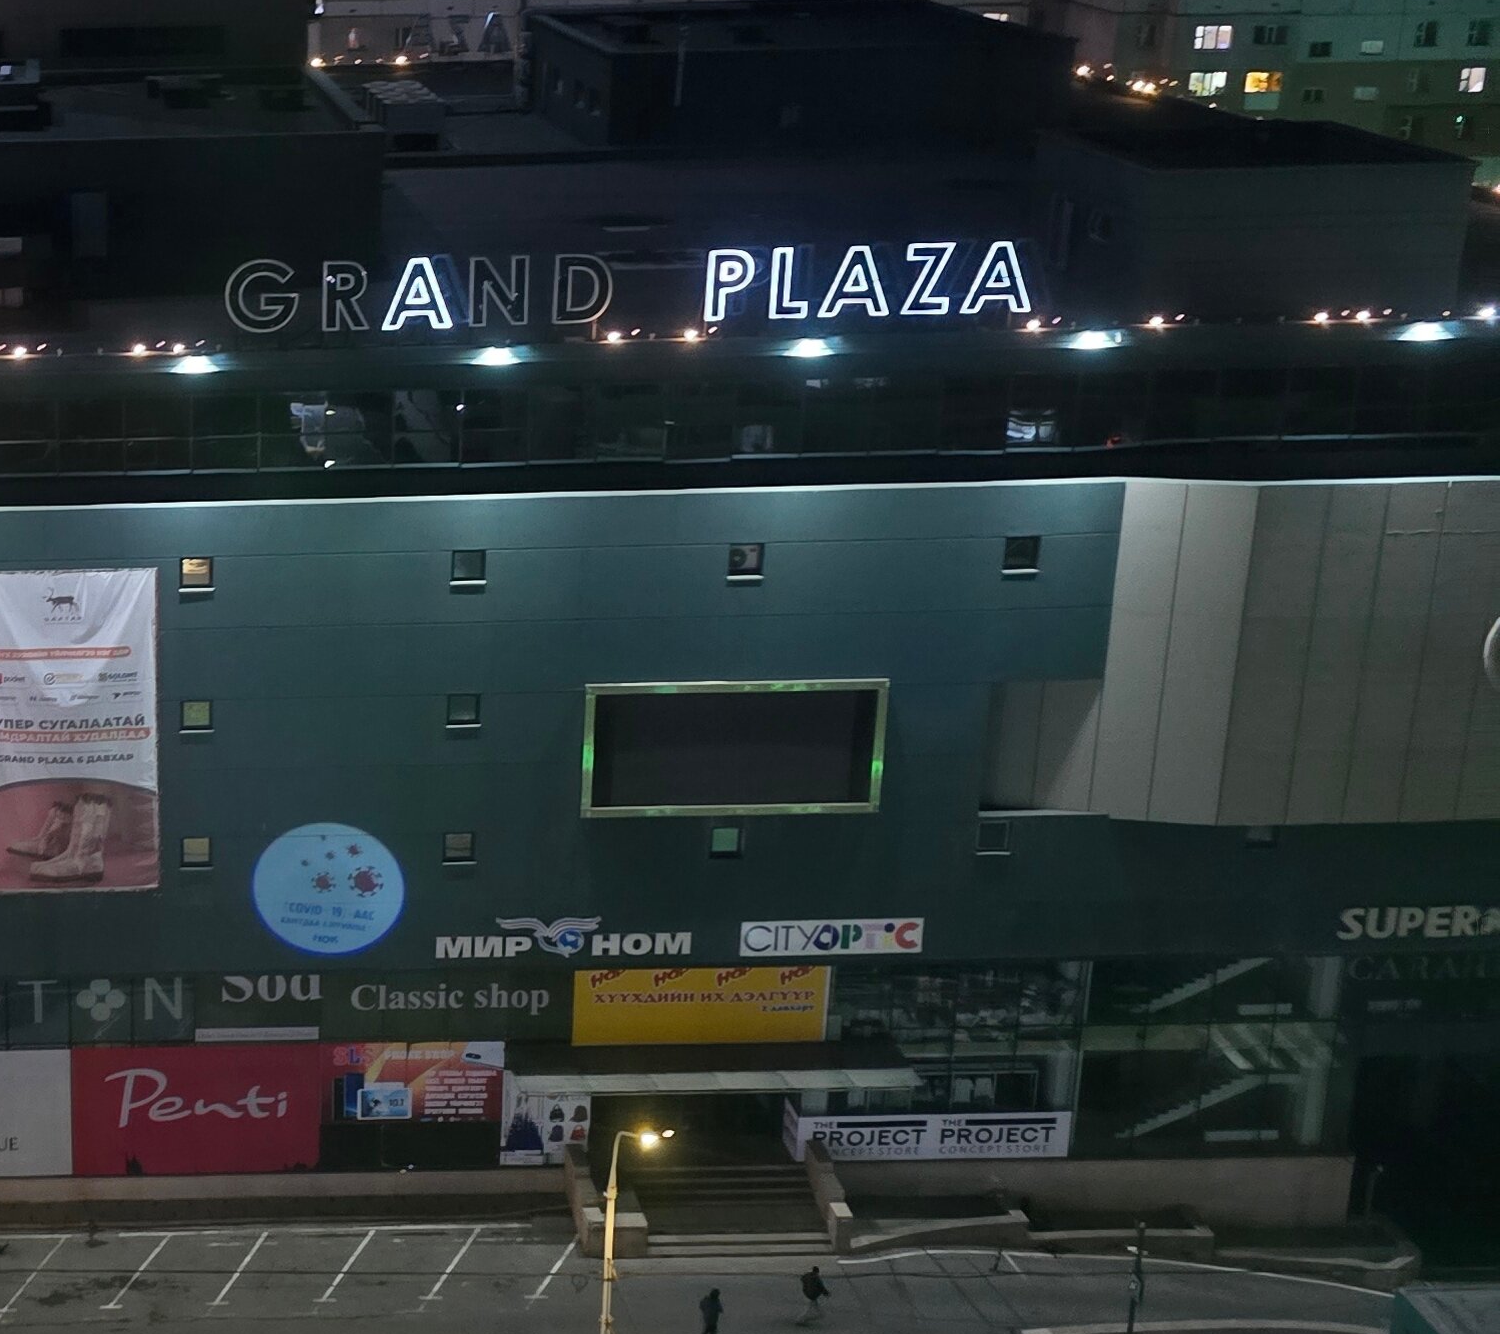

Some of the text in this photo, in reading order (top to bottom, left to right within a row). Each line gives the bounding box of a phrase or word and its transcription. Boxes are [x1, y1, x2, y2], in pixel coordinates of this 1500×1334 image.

[224, 240, 1033, 333] GRAND PLAZA
[38, 714, 146, 730] СУГАЛААТАЙ
[73, 729, 147, 742] ХУДАЛДАА
[37, 755, 74, 764] PLAZA
[86, 753, 134, 764] ДАВХАР
[435, 932, 692, 959] МИР НОМ
[351, 983, 550, 1016] Classic shop
[700, 991, 725, 1002] ИХ
[104, 1067, 289, 1129] Penti
[813, 1121, 835, 1130] THE
[942, 1119, 964, 1128] THE
[812, 1128, 927, 1147] PROJECT
[940, 1126, 1057, 1145] PROJECT
[829, 1146, 920, 1157] NCEPT STORE
[938, 1144, 1049, 1155] CONCEPT STORE
